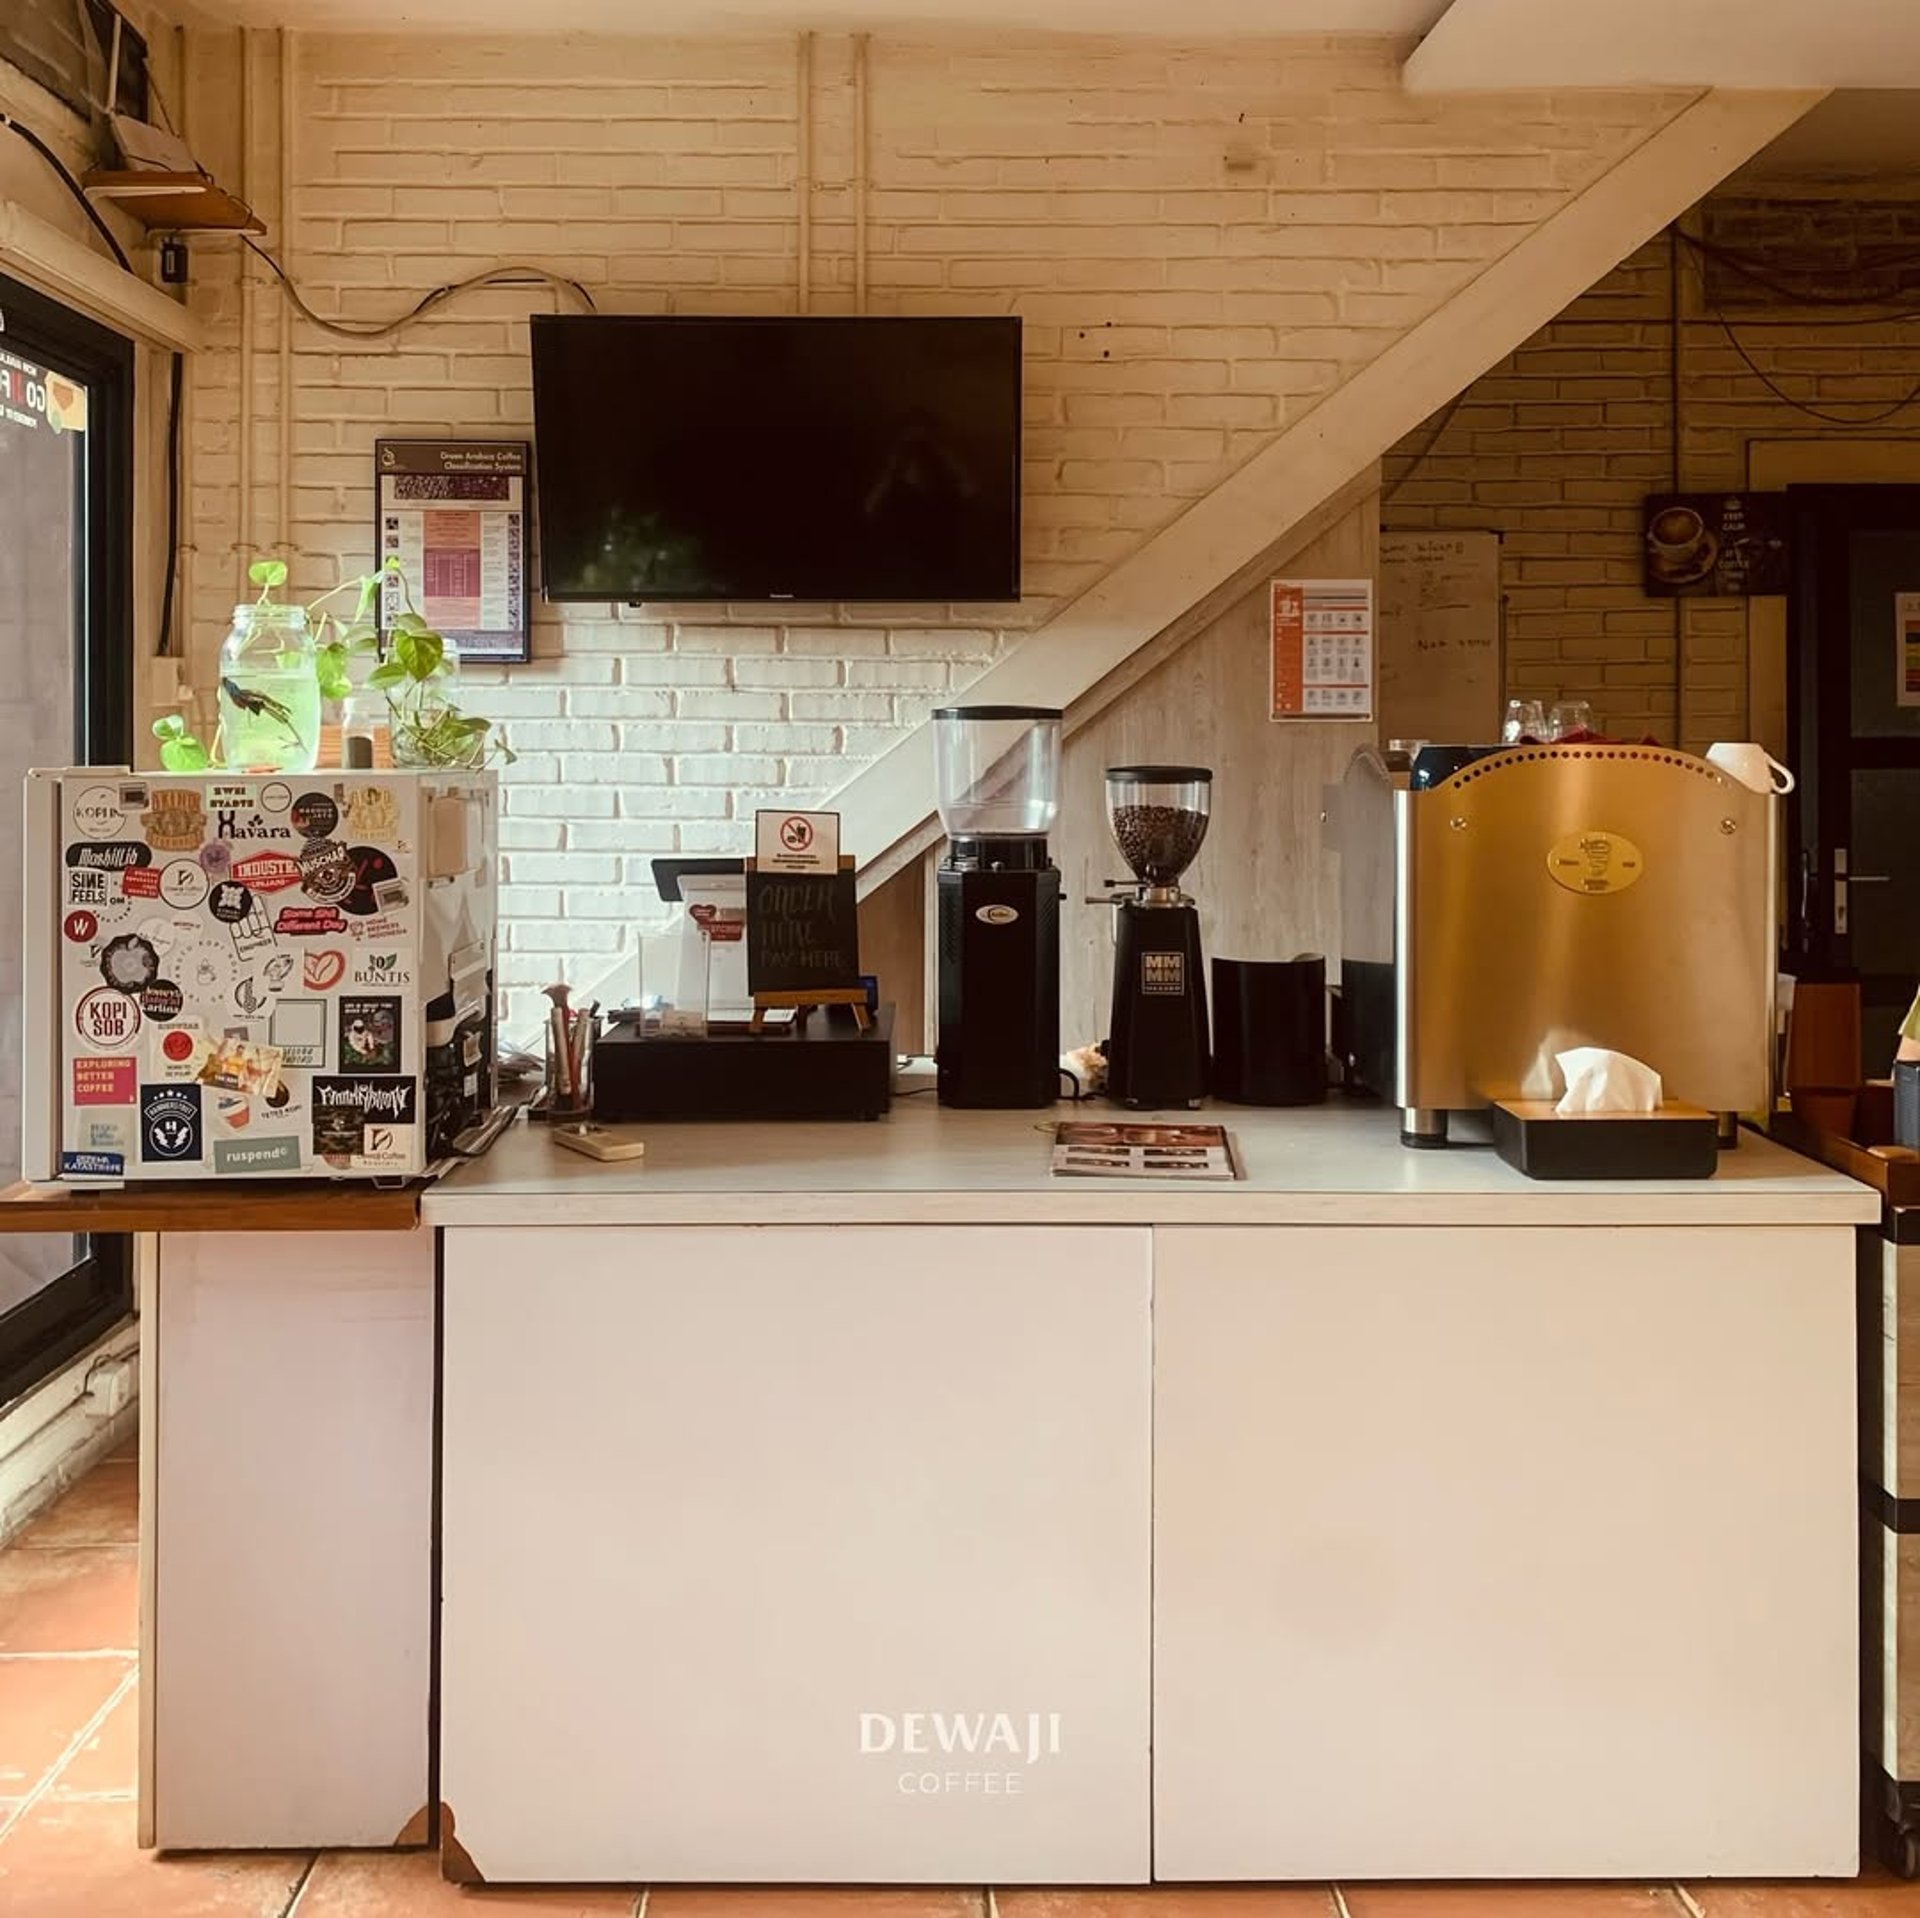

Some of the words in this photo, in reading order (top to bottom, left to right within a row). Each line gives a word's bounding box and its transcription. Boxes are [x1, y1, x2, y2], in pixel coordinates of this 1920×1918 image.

[497, 451, 521, 461] Coffee
[495, 462, 521, 472] System
[354, 970, 411, 983] BUNTIS
[89, 1002, 127, 1019] KOPI
[93, 1019, 124, 1037] SOB
[76, 1060, 131, 1069] EXPLORING
[76, 1071, 115, 1081] BETTER
[76, 1083, 115, 1093] COFFEE
[858, 1712, 1063, 1764] DEWAJI
[898, 1771, 1024, 1794] COFFEE
